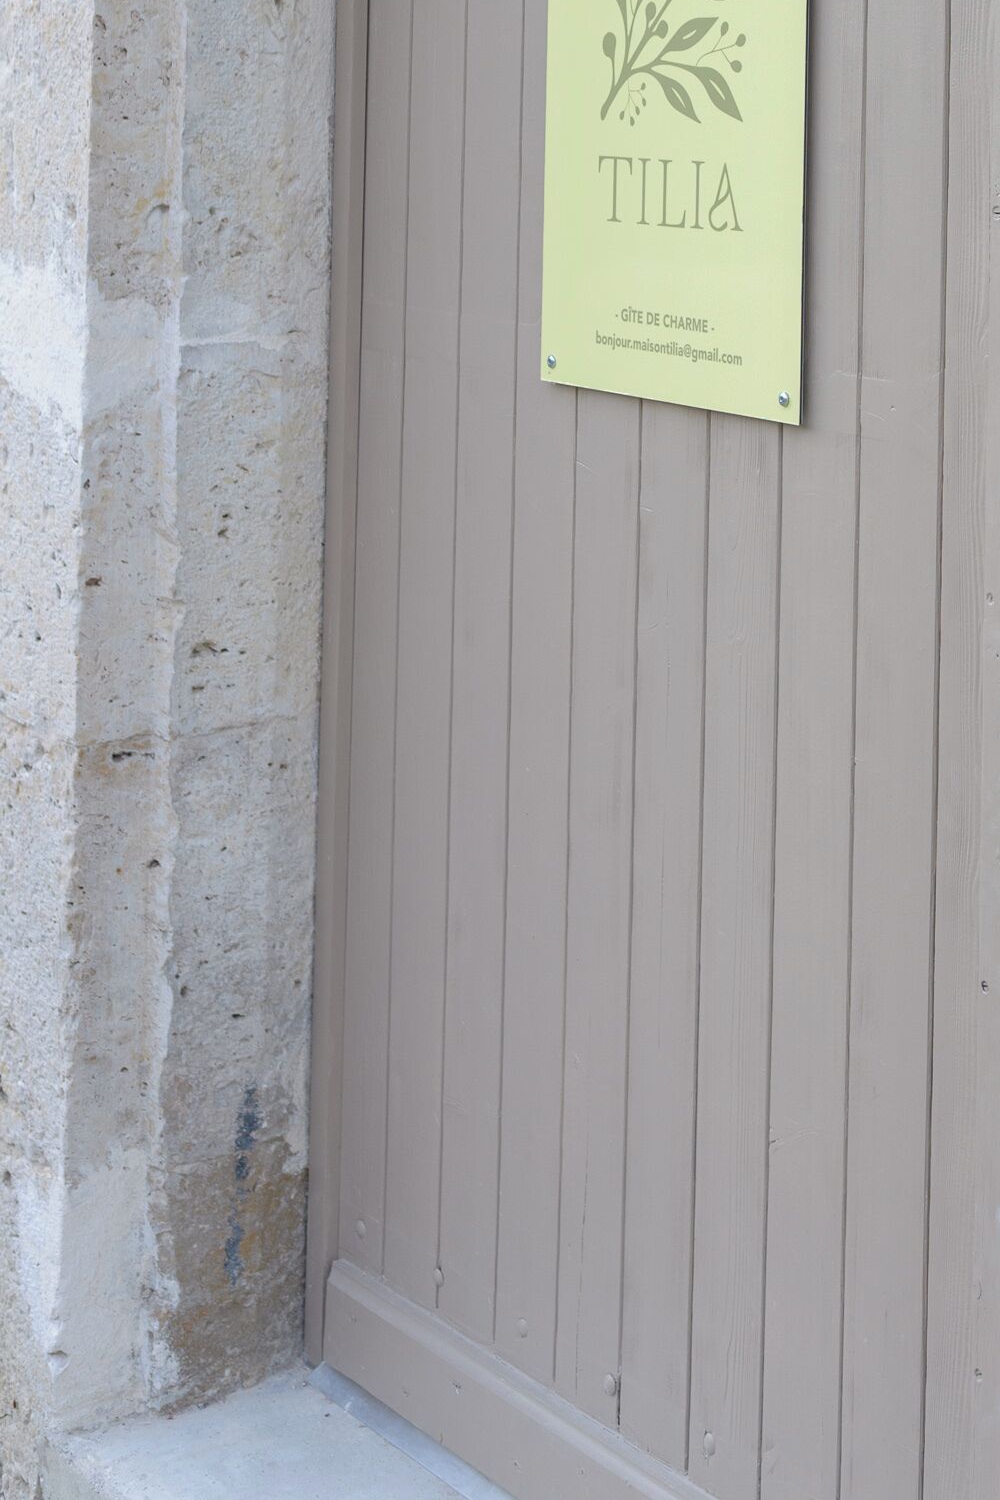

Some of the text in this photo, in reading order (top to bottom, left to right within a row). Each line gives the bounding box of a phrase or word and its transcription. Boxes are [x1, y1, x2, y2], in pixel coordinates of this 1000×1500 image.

[598, 155, 744, 233] TILIA
[620, 306, 644, 325] GÎTE
[646, 311, 660, 327] DE
[663, 314, 709, 333] CHARME
[595, 330, 743, 367] bonjour.maisontilia@gmail.com
